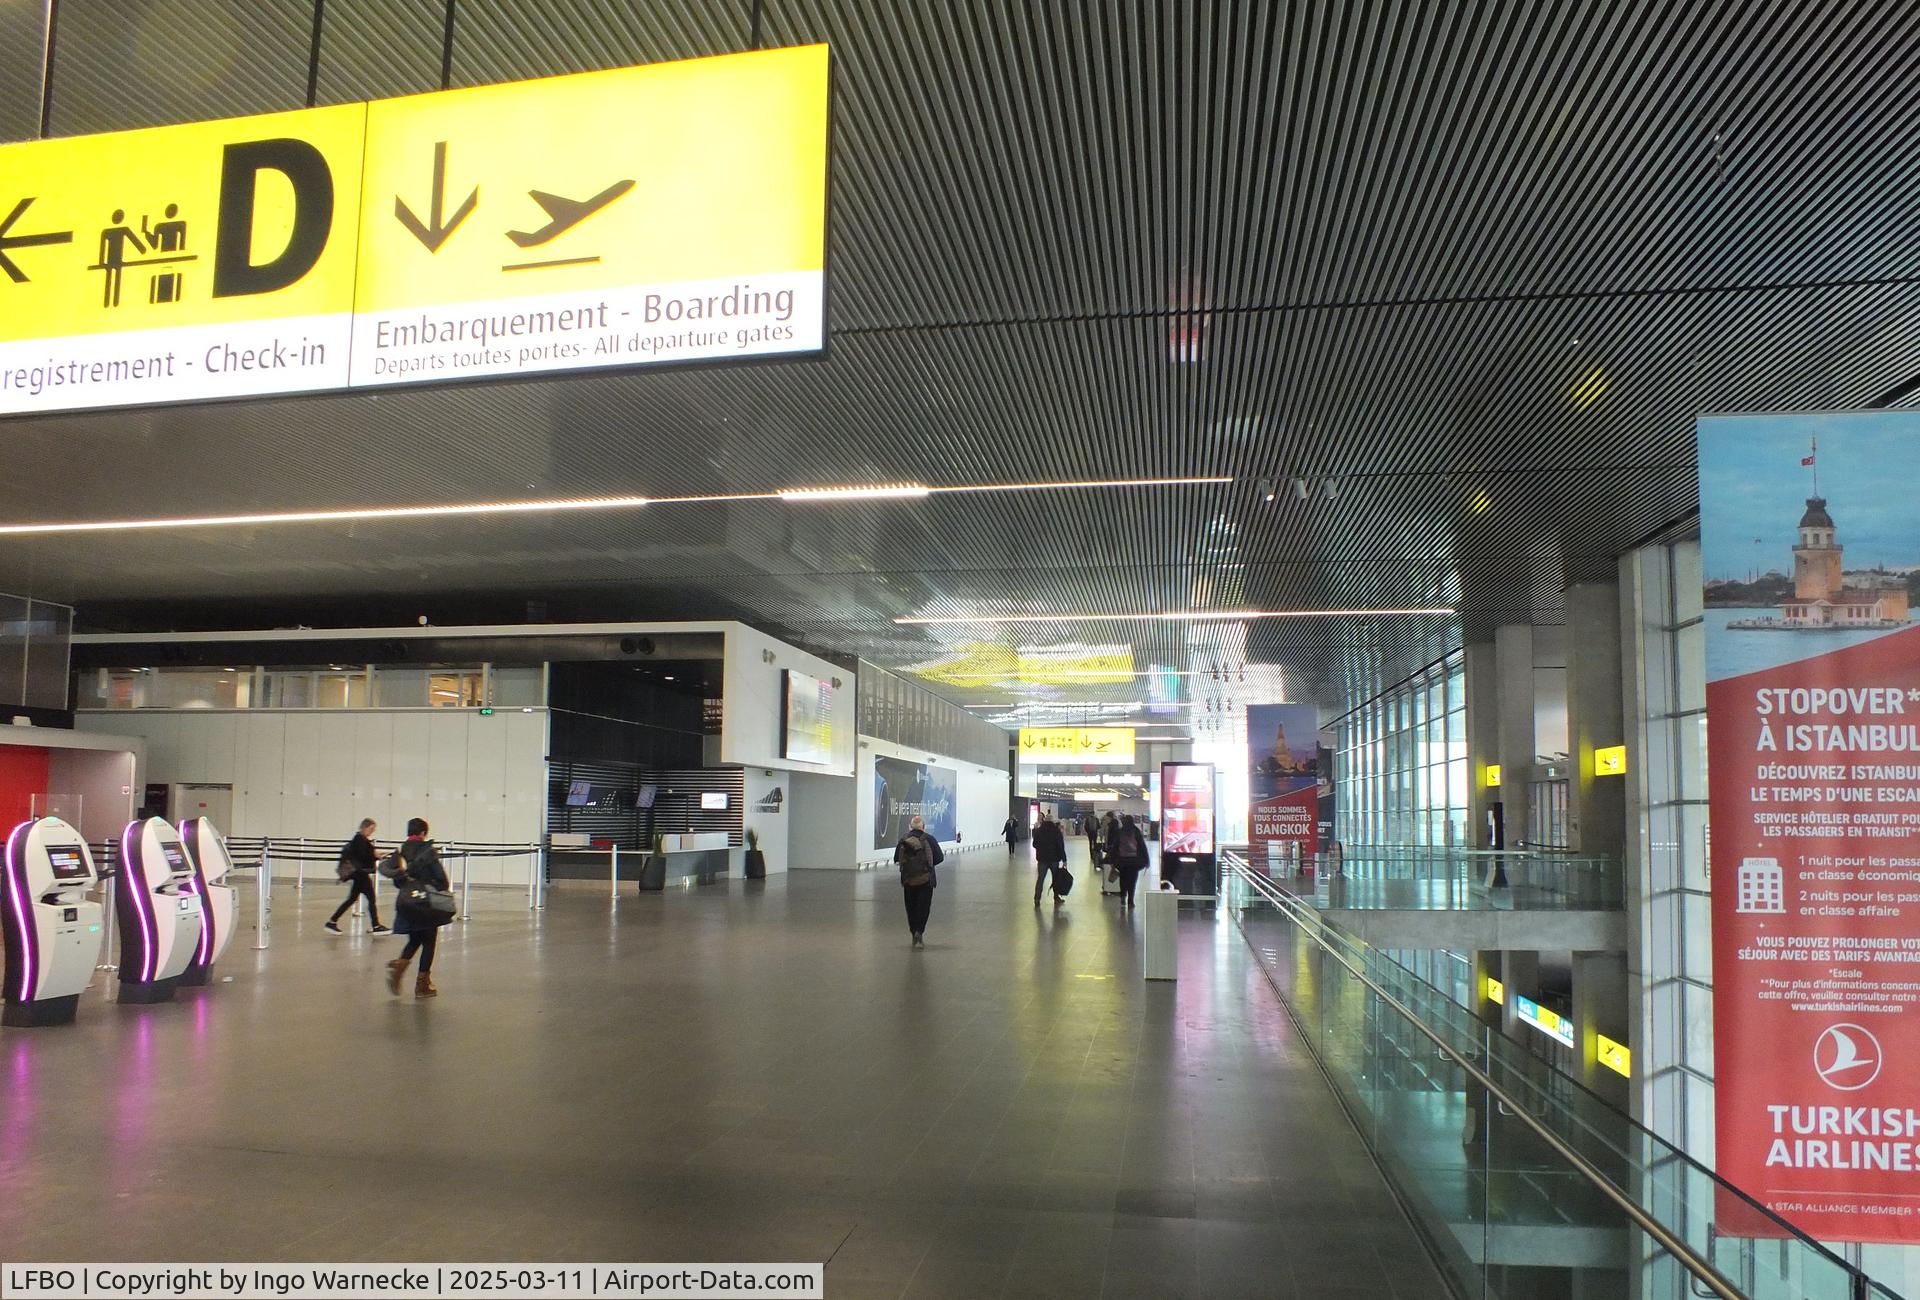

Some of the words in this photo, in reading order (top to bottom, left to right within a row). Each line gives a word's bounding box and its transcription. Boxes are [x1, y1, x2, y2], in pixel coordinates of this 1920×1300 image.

[211, 137, 334, 298] D
[377, 302, 608, 348] Embarquement
[644, 285, 794, 332] Boarding
[375, 354, 445, 377] Departs
[453, 349, 511, 368] toutes
[594, 334, 619, 354] All
[628, 330, 728, 354] departure
[737, 324, 793, 348] gates
[3, 352, 175, 395] registrement
[205, 338, 325, 373] Check-in
[1757, 718, 1776, 751] À
[1786, 725, 1920, 751] ISTANBUL
[1758, 762, 1846, 780] DÉCOUVREZ
[1751, 787, 1767, 801] LE
[1772, 788, 1822, 801] TEMPS
[1826, 788, 1872, 802] D'UNE
[1754, 813, 1798, 824] SERVICE
[1801, 811, 1850, 824] HÔTELIER
[1854, 813, 1898, 824] GRATUIT
[1255, 823, 1310, 834] BANGKOK
[1763, 826, 1781, 836] LES
[1784, 826, 1844, 837] PASSAGERS
[1848, 827, 1862, 837] EN
[1799, 856, 1804, 865] 1
[1808, 856, 1832, 866] nuit
[1835, 858, 1864, 868] pour
[1868, 856, 1886, 866] les
[1799, 872, 1815, 880] en
[1818, 870, 1853, 880] classe
[1800, 891, 1807, 901] 2
[1810, 890, 1839, 901] nuits
[1843, 893, 1873, 903] pour
[1877, 891, 1894, 901] les
[1800, 907, 1815, 916] en
[1818, 905, 1854, 916] classe
[1858, 905, 1900, 916] affaire
[1756, 937, 1784, 947] VOUS
[1788, 937, 1829, 948] POUVEZ
[1833, 938, 1897, 949] PROLONGER
[1738, 947, 1777, 960] SÉJOUR
[1780, 950, 1808, 960] AVEC
[1811, 951, 1830, 961] DES
[1834, 951, 1870, 962] TARIFS
[1793, 979, 1811, 990] plus
[1758, 991, 1782, 999] cette
[1811, 991, 1843, 1000] veuillez
[1846, 992, 1890, 1001] consulter
[1892, 992, 1916, 1001] notre
[1791, 1003, 1903, 1013] www.turkishairlines.com
[1767, 1105, 1920, 1137] TURKISH
[1776, 1203, 1803, 1212] STAR
[1806, 1204, 1857, 1213] ALLIANCE
[1861, 1205, 1912, 1215] MEMBER
